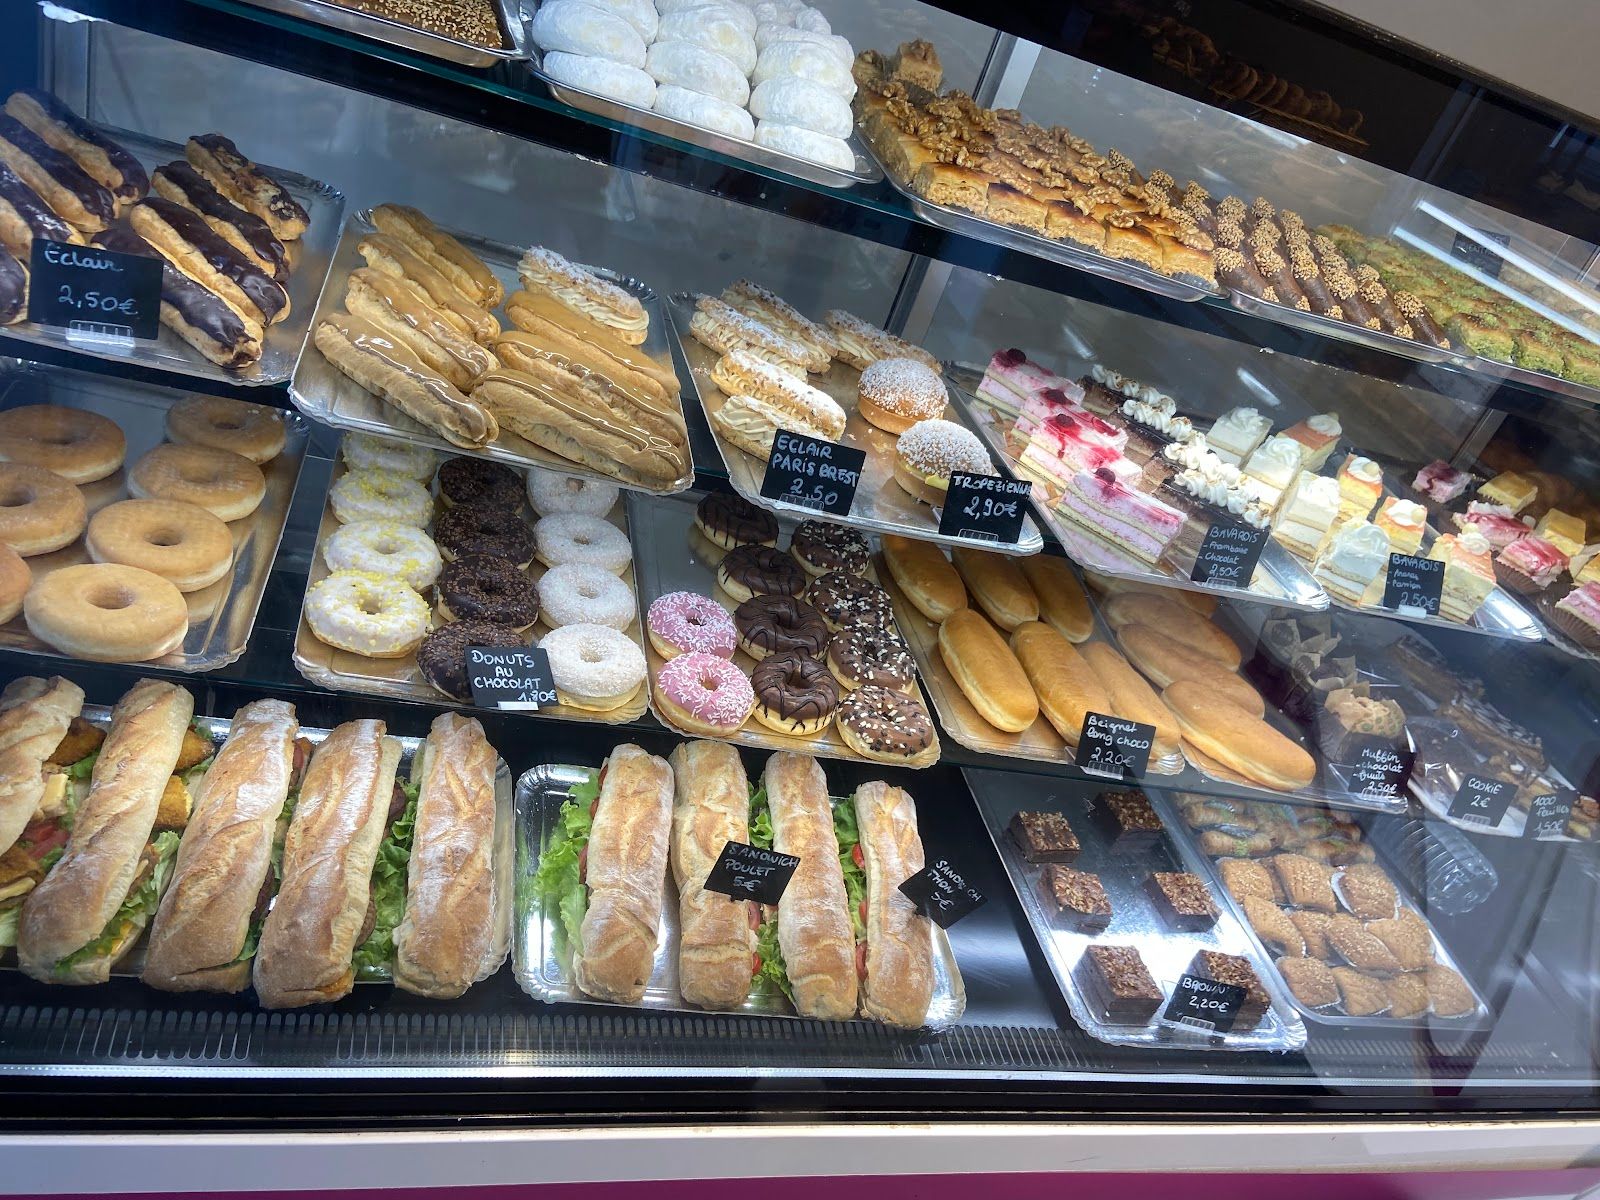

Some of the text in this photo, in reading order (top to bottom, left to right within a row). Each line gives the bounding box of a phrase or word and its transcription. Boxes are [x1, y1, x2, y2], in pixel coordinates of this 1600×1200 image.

[59, 284, 139, 315] 2,50€
[819, 463, 860, 488] BREST
[963, 495, 1018, 521] 2,90€
[471, 649, 536, 669] DONUTS
[495, 665, 514, 678] AU
[473, 676, 541, 690] CHOCOLAT
[1087, 715, 1138, 735] Beignet
[1086, 726, 1150, 750] long choco
[1090, 746, 1136, 768] 2,20€
[1361, 747, 1401, 764] Muffin
[1470, 794, 1491, 808] 2€
[1532, 795, 1557, 807] 1000
[727, 843, 800, 869] SANDWICH
[724, 858, 776, 877] POULET
[733, 875, 761, 893] 5€
[927, 868, 955, 894] THON
[930, 891, 955, 911] 5€
[1188, 995, 1230, 1013] 2,20€
